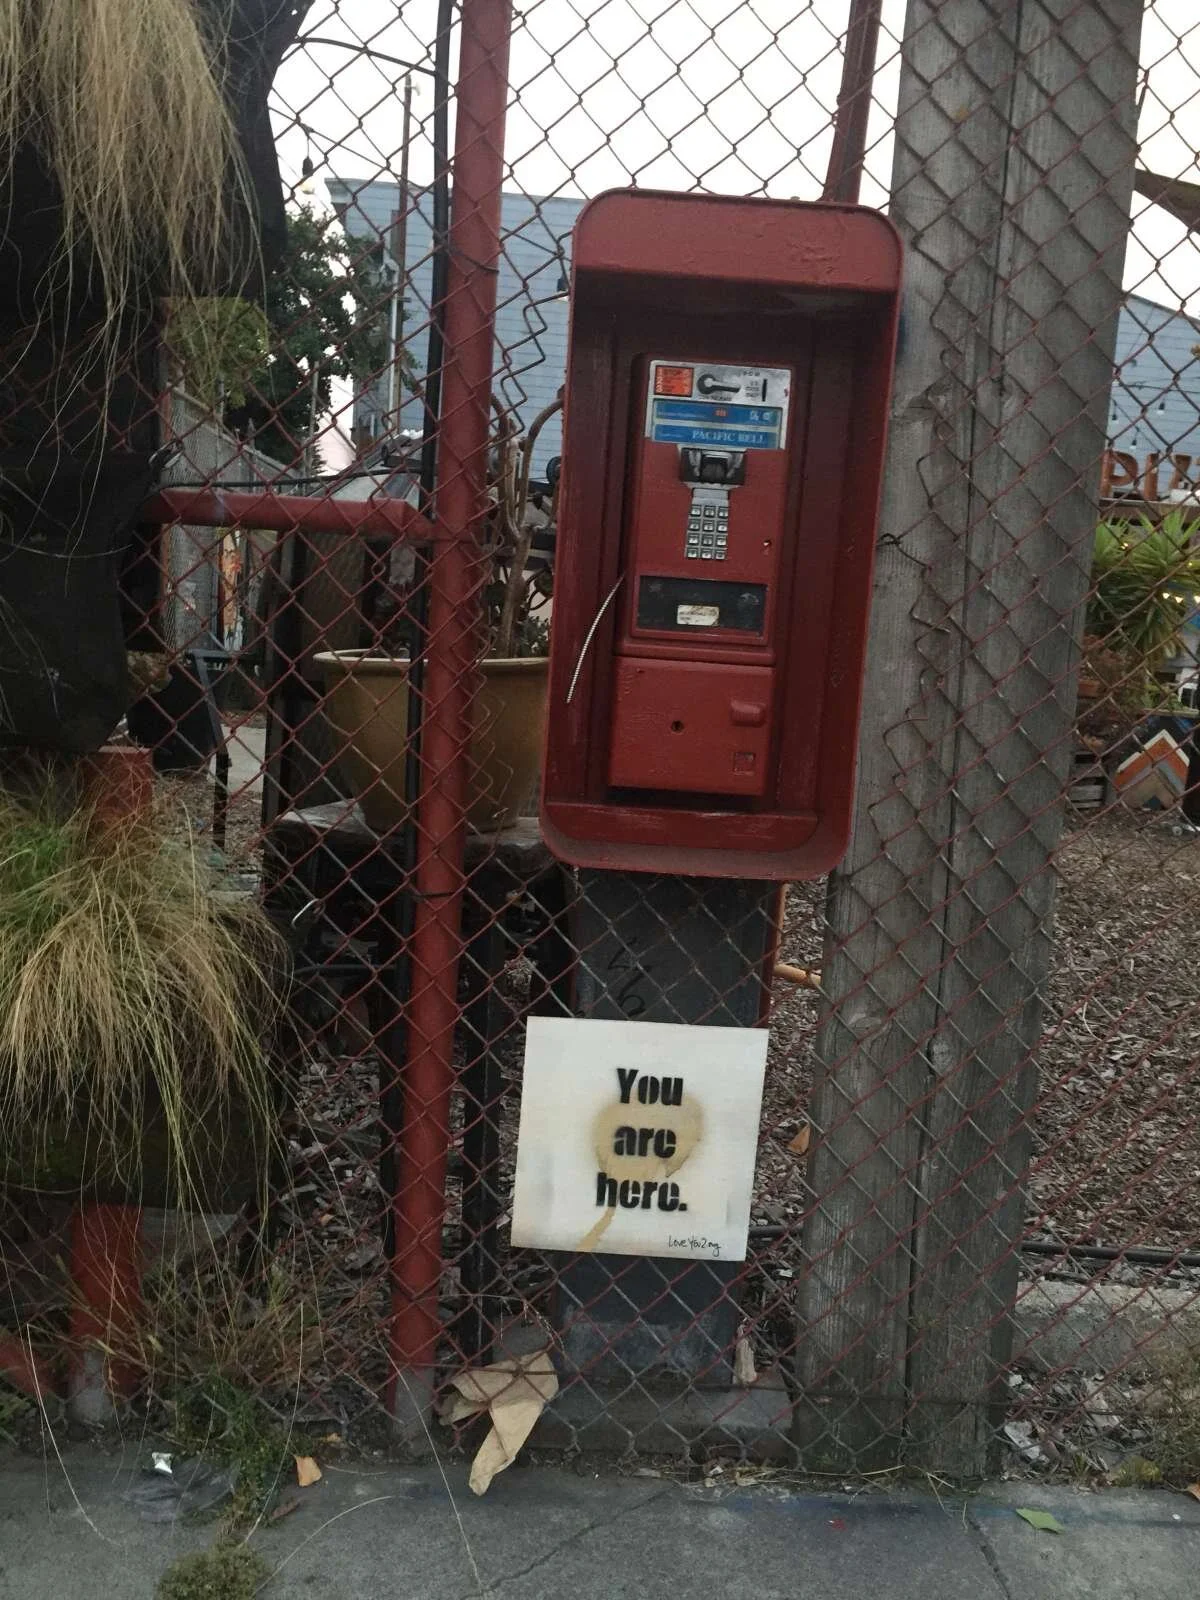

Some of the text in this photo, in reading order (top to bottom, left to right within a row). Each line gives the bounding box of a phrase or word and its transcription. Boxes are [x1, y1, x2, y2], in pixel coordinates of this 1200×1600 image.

[692, 430, 735, 442] PACIFIC
[738, 434, 765, 445] BELL
[616, 1068, 683, 1106] You
[613, 1126, 676, 1158] are
[596, 1172, 688, 1211] here.
